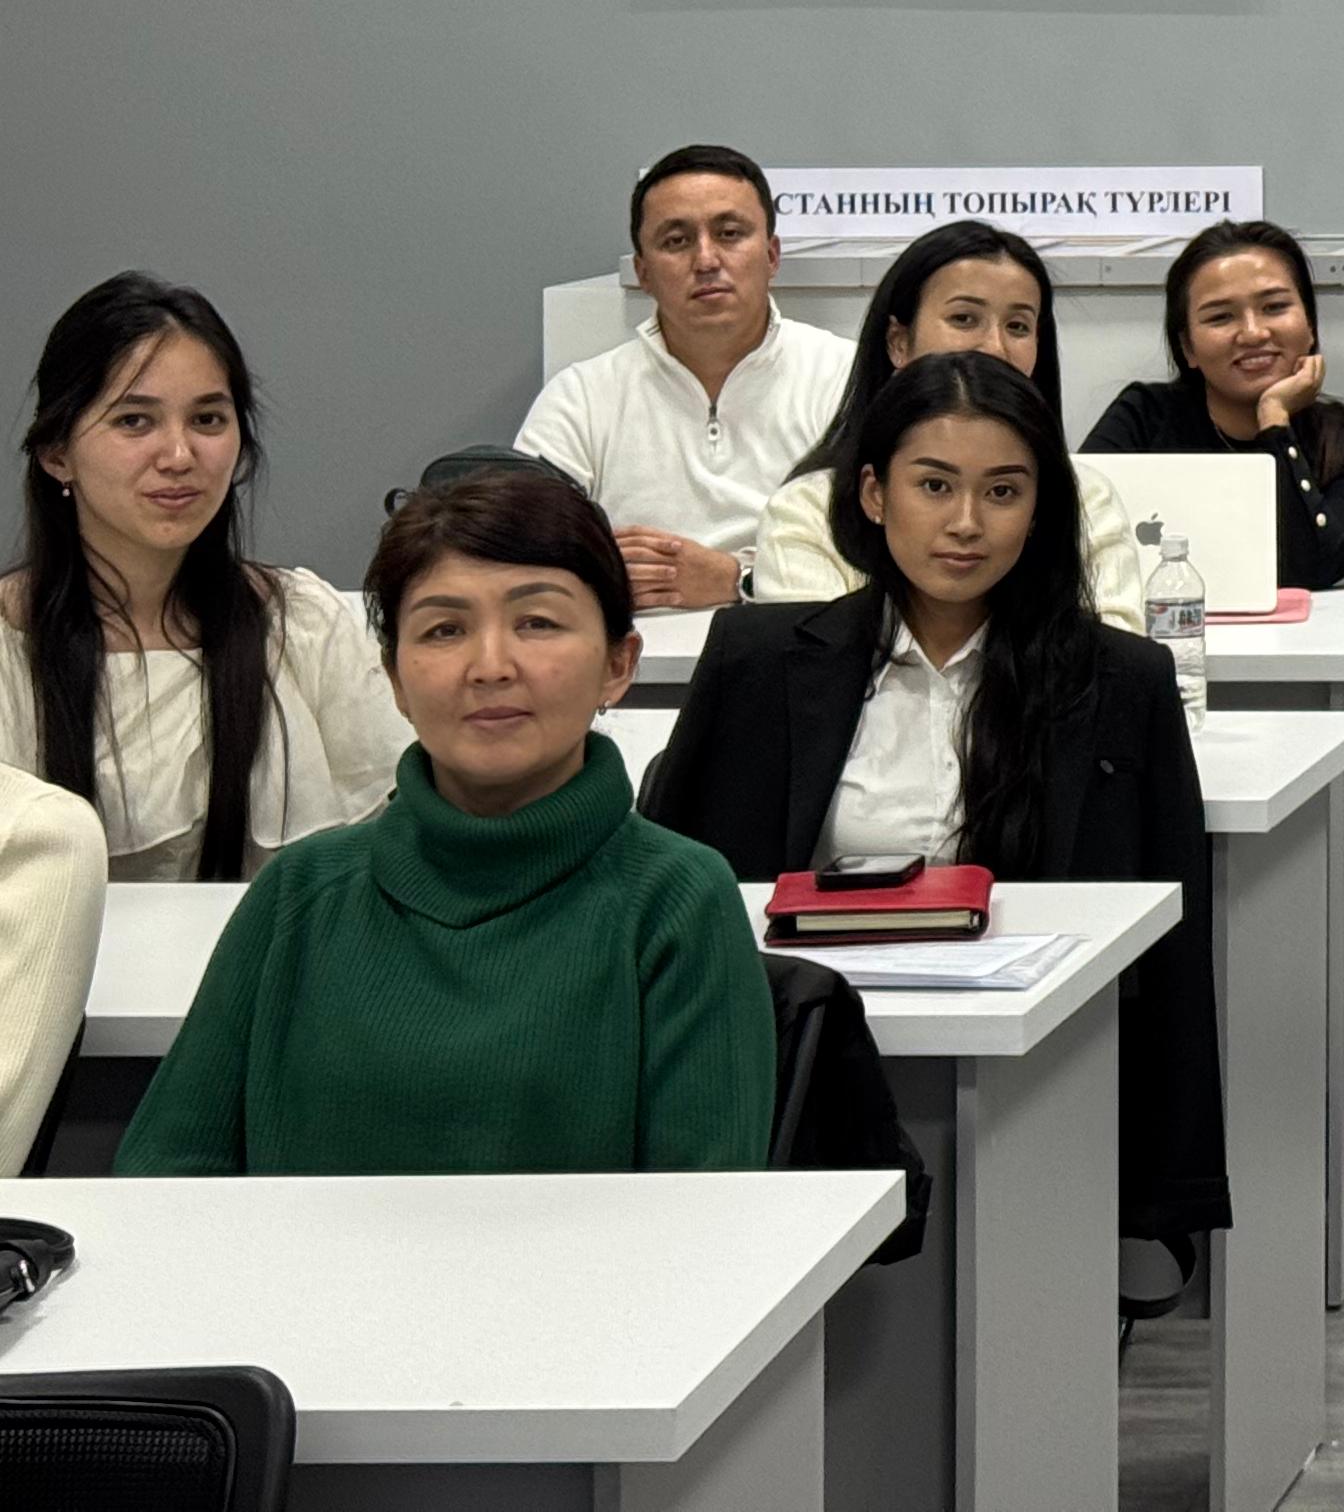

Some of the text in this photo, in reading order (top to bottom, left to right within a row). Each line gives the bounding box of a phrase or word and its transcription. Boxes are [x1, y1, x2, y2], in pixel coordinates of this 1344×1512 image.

[774, 190, 1231, 218] СТАННЫҢ ТОПЫРАҚ ТҮРЛЕРІ
